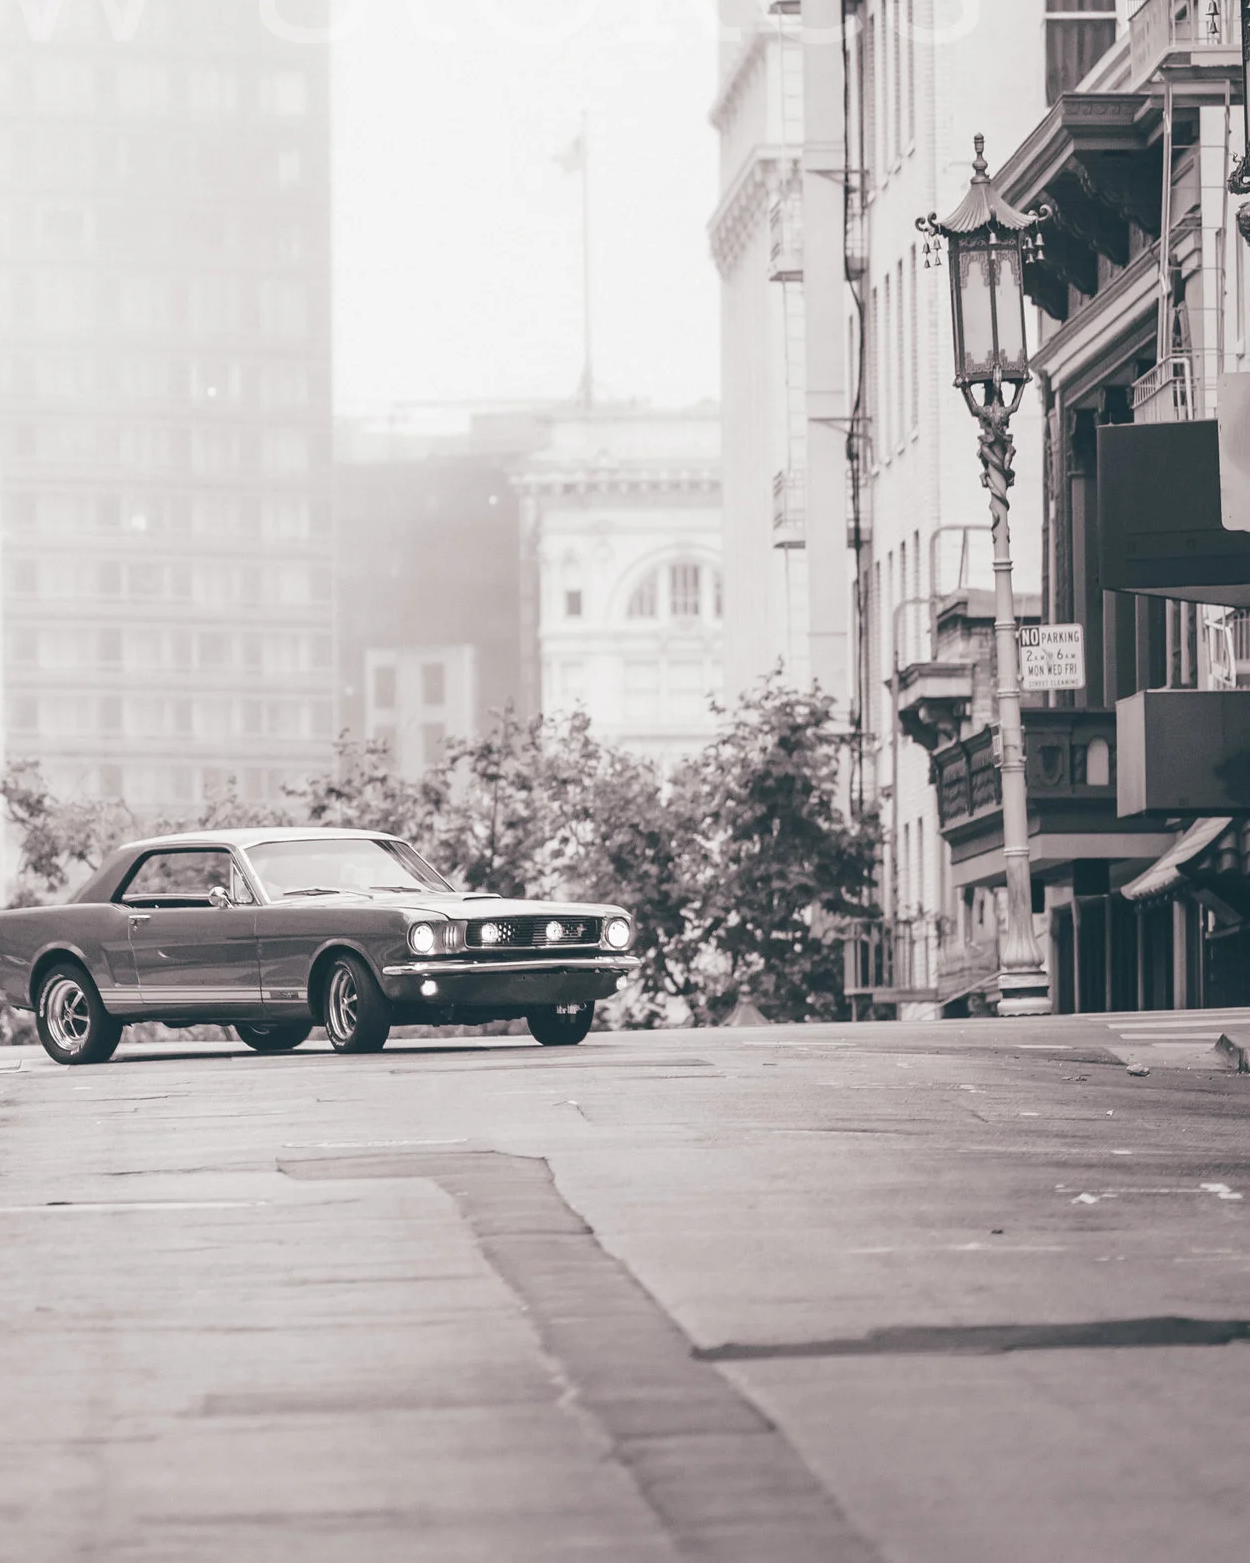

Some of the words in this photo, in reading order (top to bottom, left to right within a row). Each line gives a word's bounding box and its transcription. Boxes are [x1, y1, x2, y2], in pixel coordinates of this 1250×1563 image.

[1021, 628, 1039, 646] NO
[1041, 631, 1080, 644] PARKING
[1028, 664, 1045, 676] MON
[1047, 663, 1063, 675] WED
[1064, 662, 1077, 675] FRI
